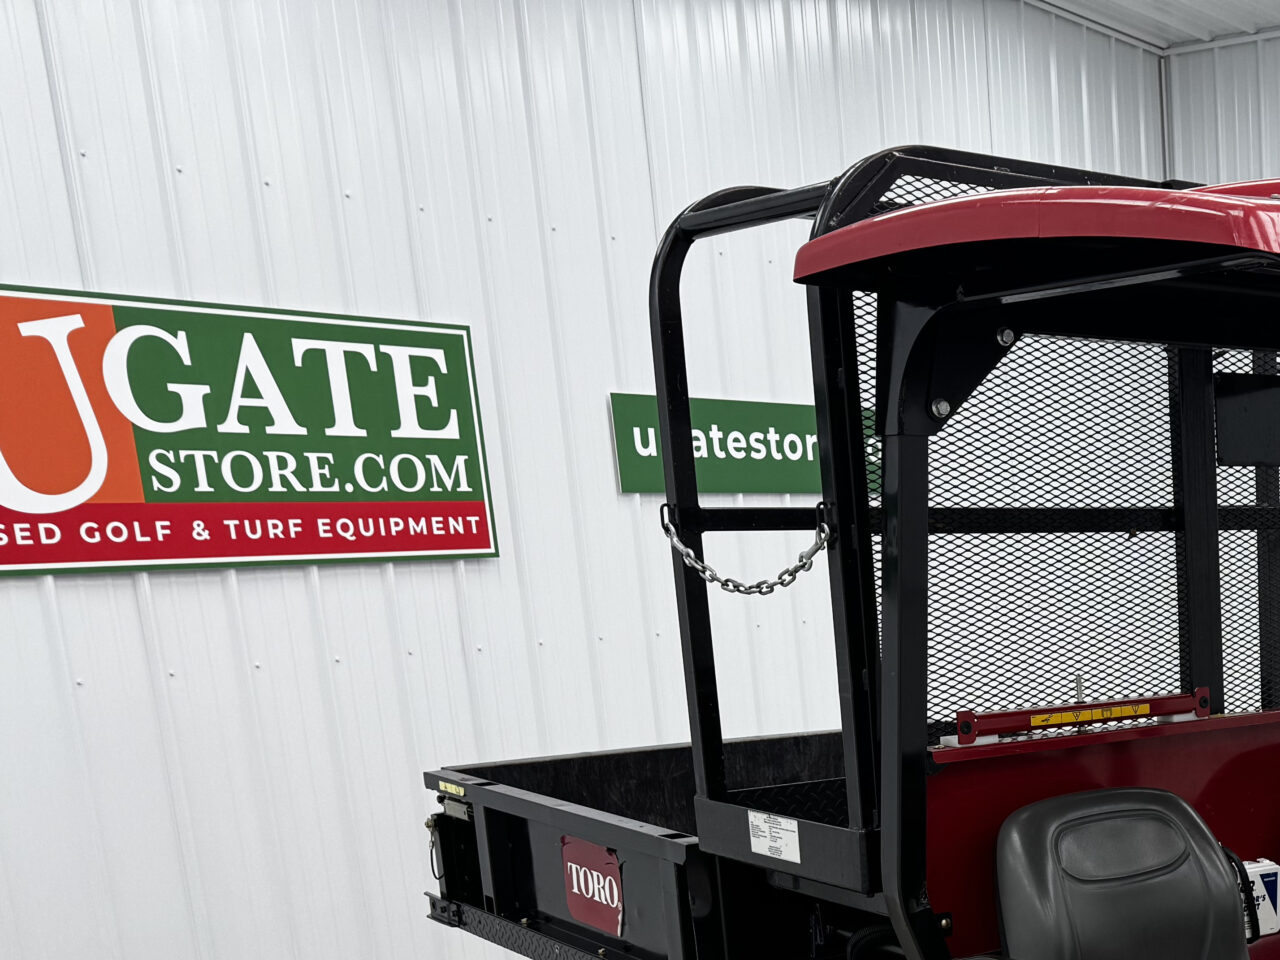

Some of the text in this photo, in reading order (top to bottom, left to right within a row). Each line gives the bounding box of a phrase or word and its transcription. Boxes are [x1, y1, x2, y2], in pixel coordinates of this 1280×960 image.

[148, 448, 473, 494] STORE.COM
[79, 521, 172, 544] GOLF
[191, 520, 211, 542] &
[223, 518, 304, 541] TURF
[317, 515, 481, 540] EQUIPMENT
[567, 862, 619, 908] TORO
